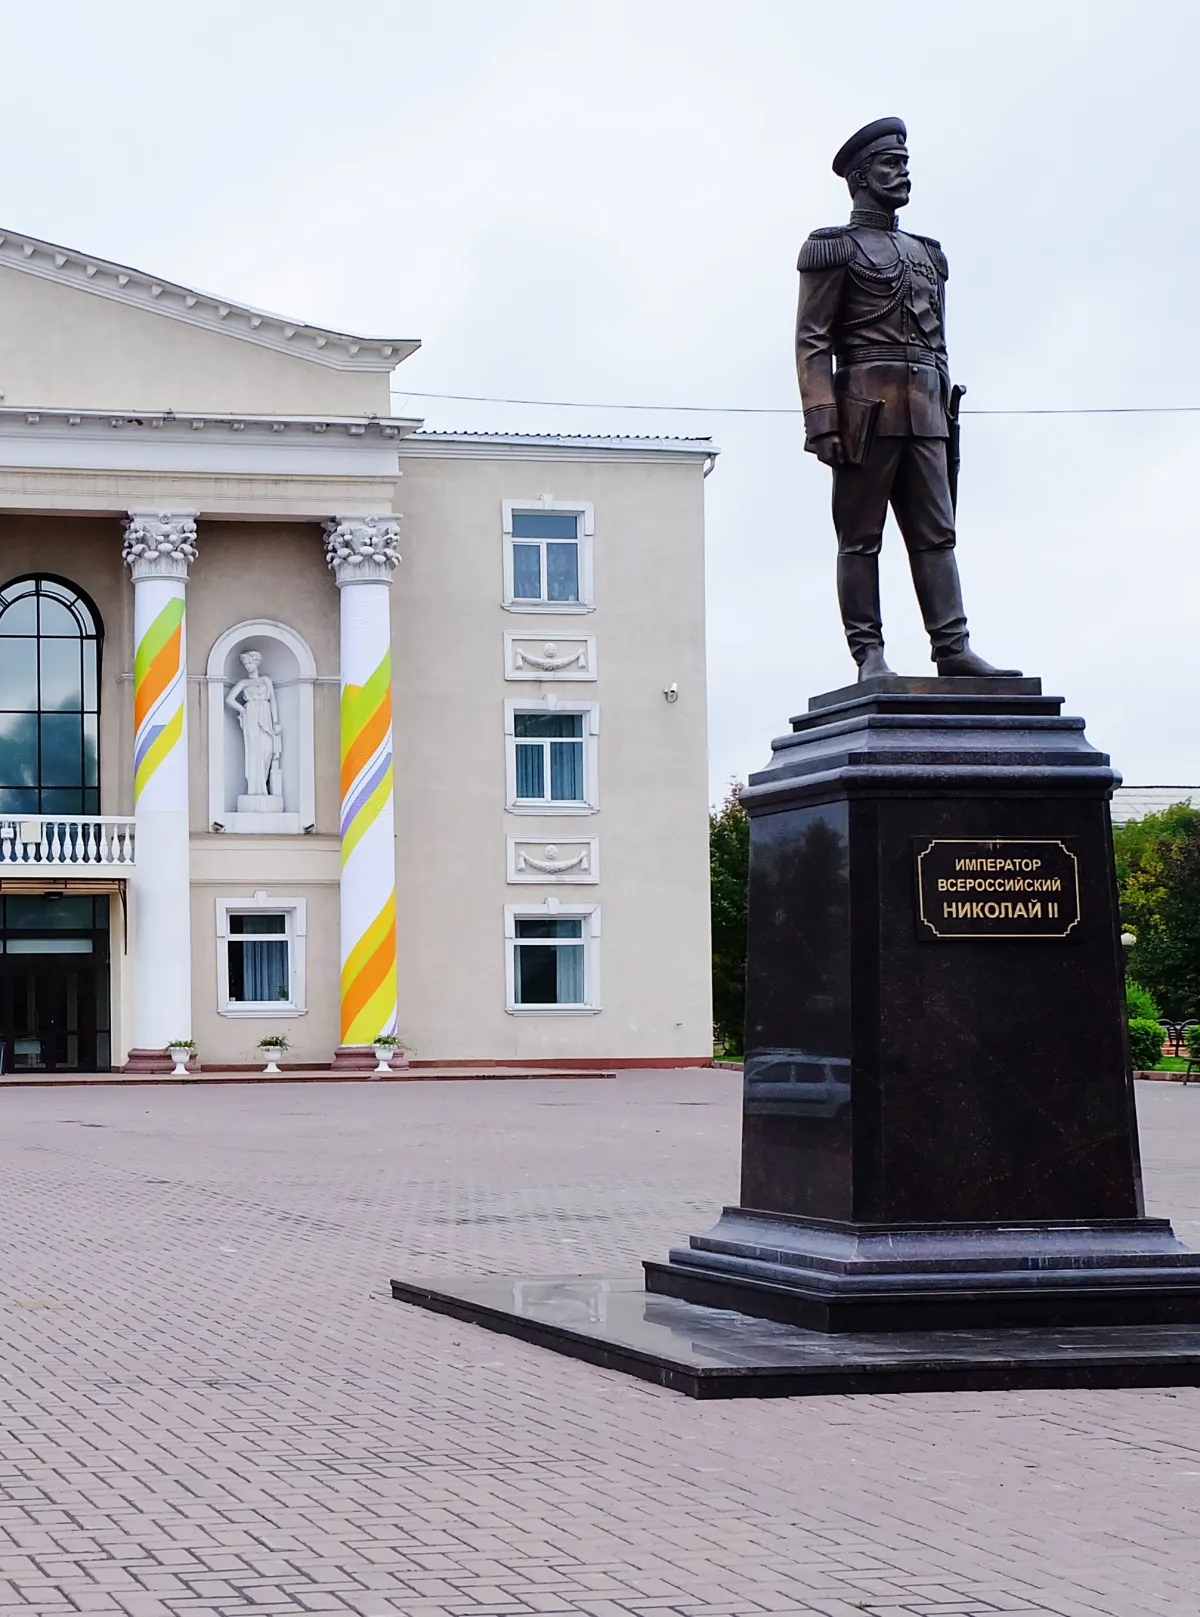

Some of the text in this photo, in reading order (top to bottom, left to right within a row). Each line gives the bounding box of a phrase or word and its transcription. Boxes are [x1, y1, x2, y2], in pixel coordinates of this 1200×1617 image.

[955, 858, 1042, 872] ИМПЕРАТОР
[937, 876, 1062, 892] ВСЕРОССИЙСКИЙ
[943, 898, 1059, 919] НИКОЛАЙ II
